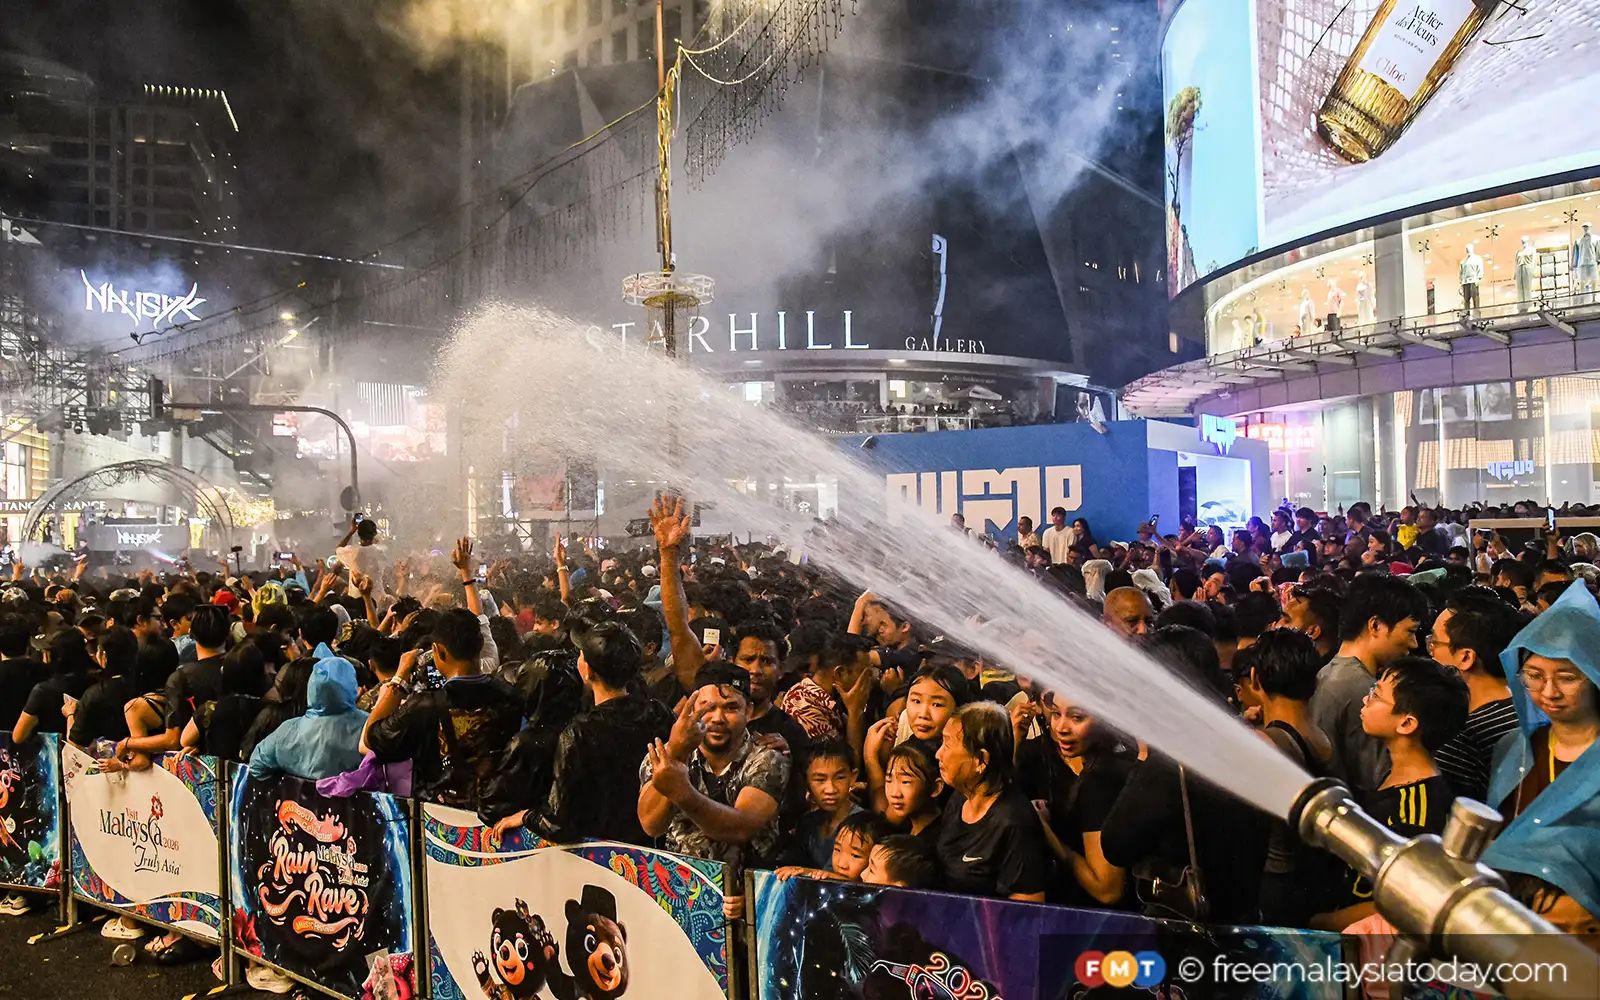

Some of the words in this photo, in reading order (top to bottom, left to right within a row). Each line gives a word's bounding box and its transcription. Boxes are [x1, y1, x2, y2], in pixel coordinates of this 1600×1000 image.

[1406, 18, 1438, 47] Fleurs
[1408, 5, 1443, 30] Atelier
[585, 310, 869, 352] STARHILL
[905, 336, 986, 354] GALLERY
[99, 808, 163, 848] Malaysia
[133, 844, 160, 873] Truly
[161, 858, 181, 876] Asia
[273, 836, 319, 884] Rain
[303, 871, 361, 922] Rave
[924, 952, 1004, 1000] 202
